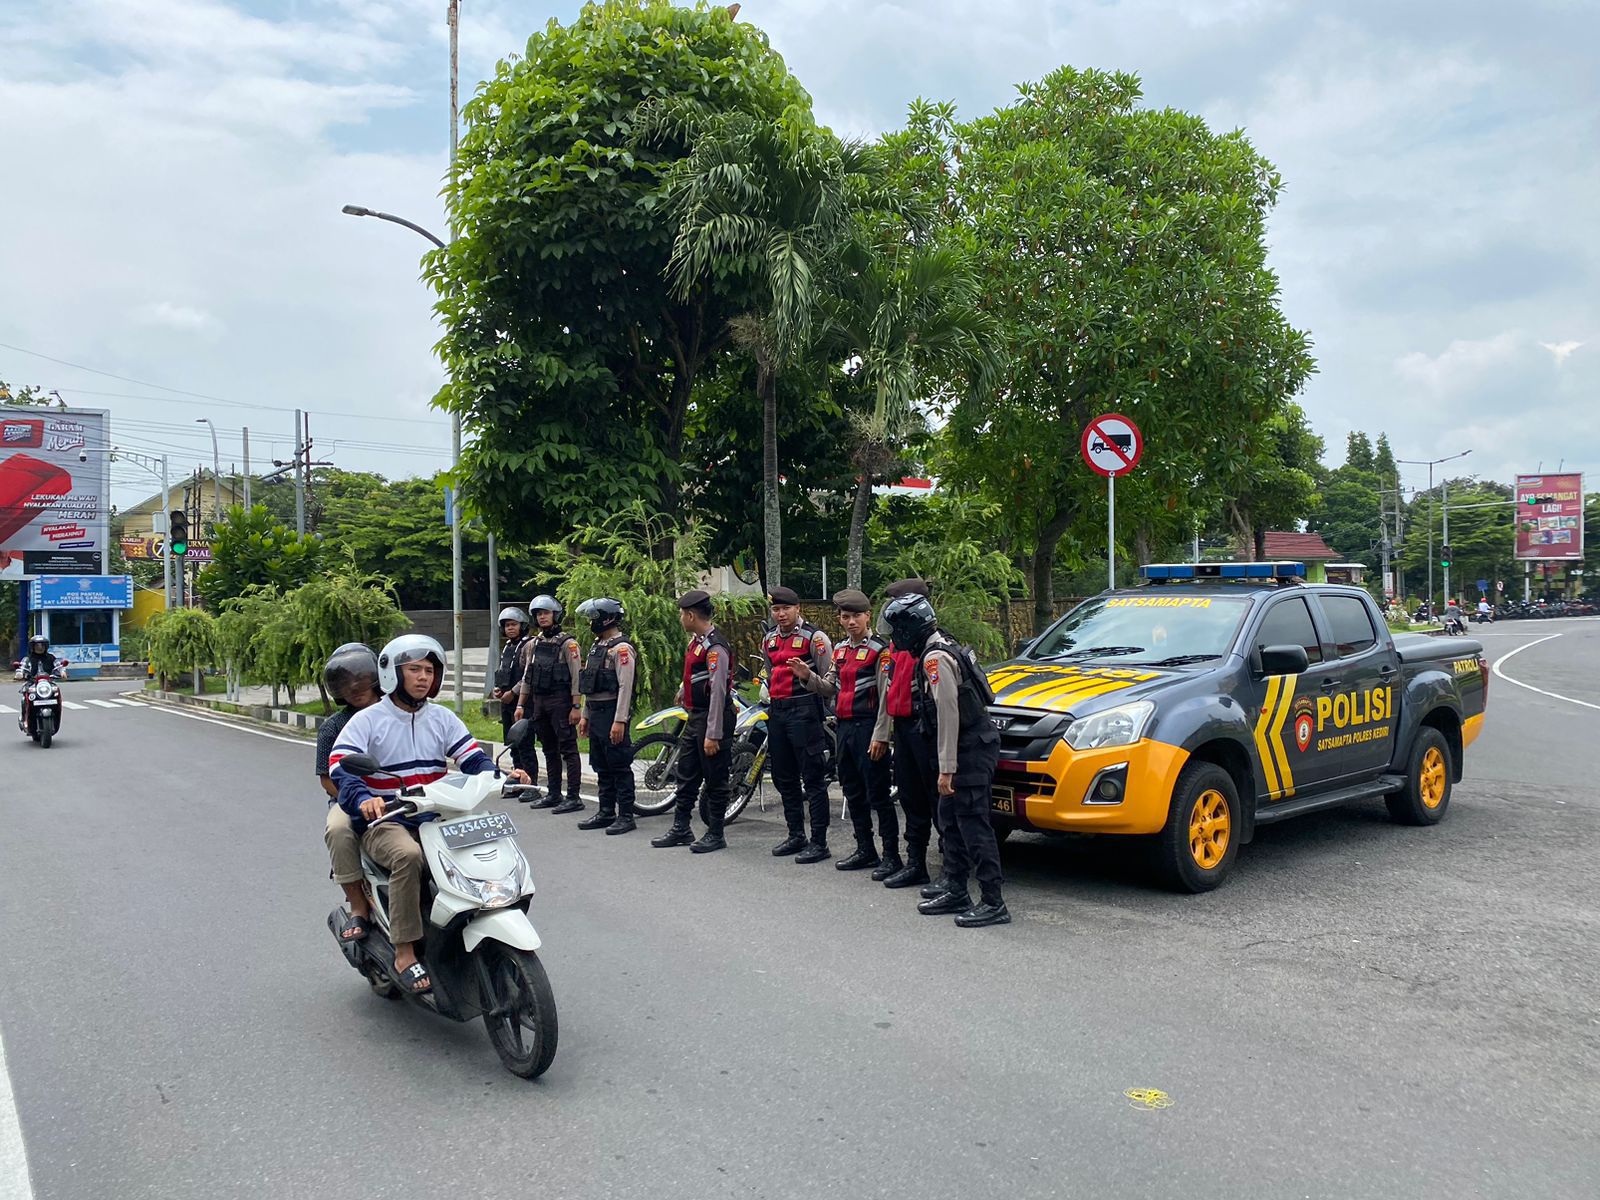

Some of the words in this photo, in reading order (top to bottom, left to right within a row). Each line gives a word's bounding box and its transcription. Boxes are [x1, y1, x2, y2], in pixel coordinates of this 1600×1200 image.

[46, 432, 85, 451] Merah
[58, 511, 96, 519] MERAH
[1105, 597, 1212, 609] SATSAMAPTA
[991, 665, 1162, 681] POLISI
[1316, 686, 1392, 732] POLISI
[1317, 733, 1353, 751] SATSAMAPTA
[1352, 729, 1373, 744] POLRES
[442, 825, 459, 837] AG
[458, 818, 488, 834] 2546
